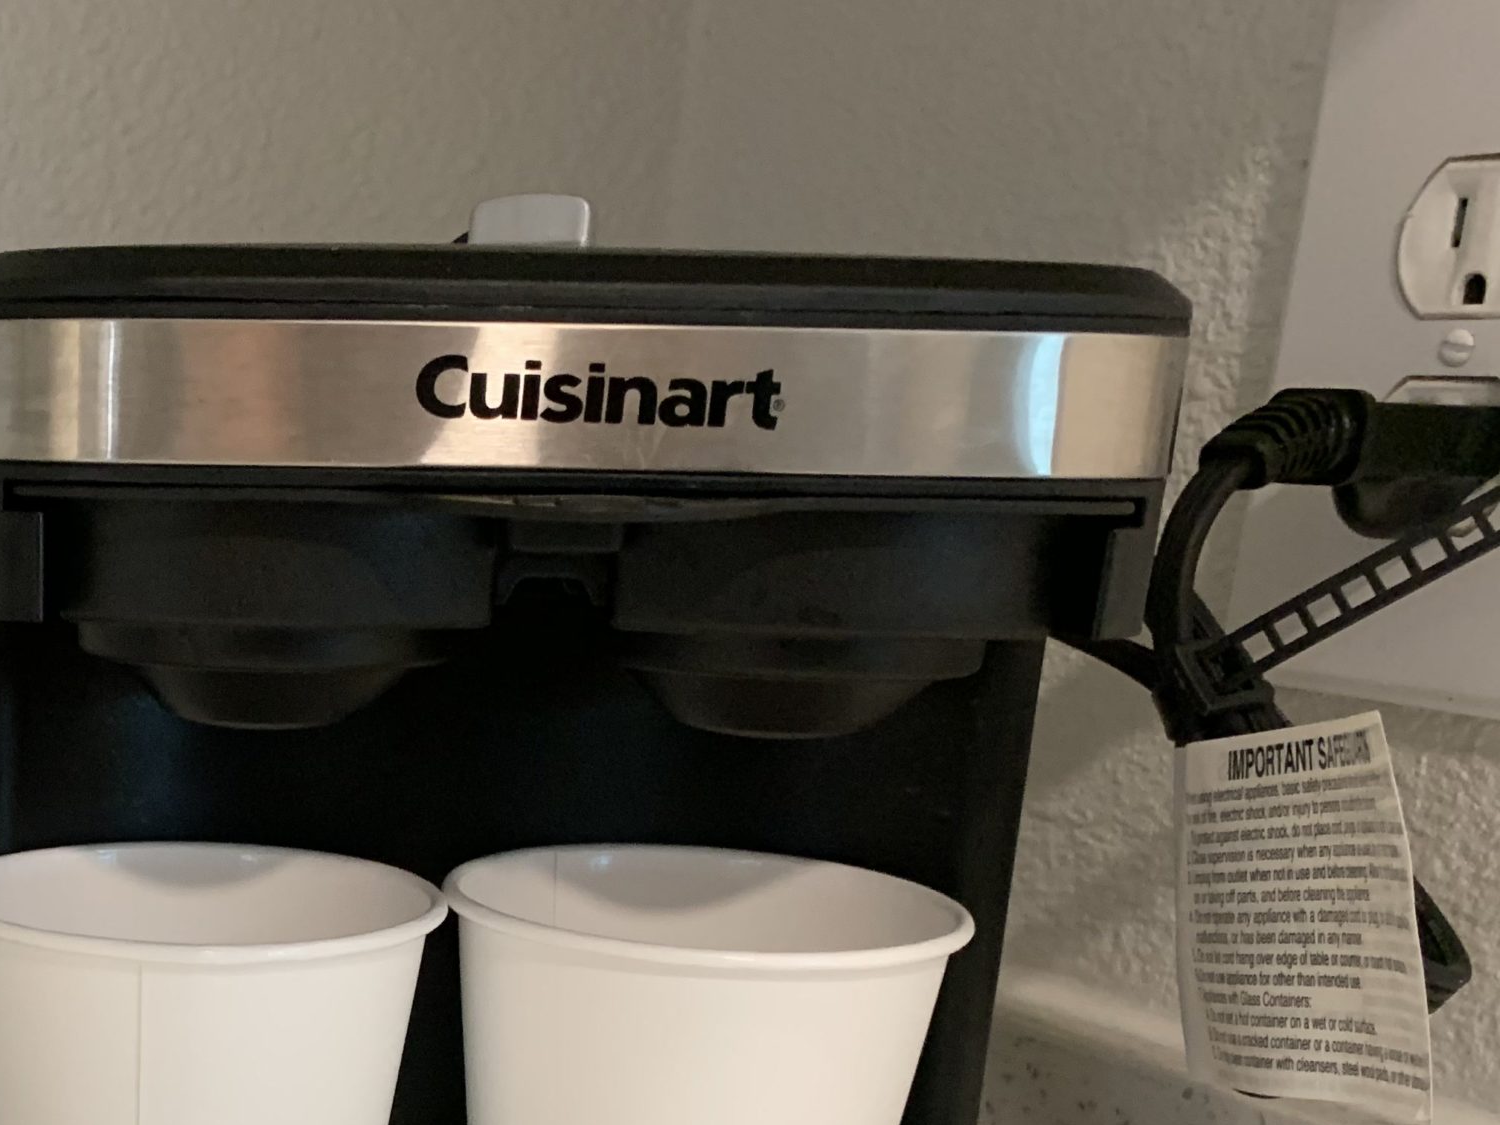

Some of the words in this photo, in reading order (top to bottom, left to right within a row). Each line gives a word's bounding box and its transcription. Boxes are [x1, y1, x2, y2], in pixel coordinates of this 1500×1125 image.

[416, 354, 782, 431] Cuisinart
[1228, 739, 1314, 781] IMPORTANT
[1256, 847, 1295, 863] necessary
[1297, 844, 1317, 858] when
[1249, 867, 1271, 882] when
[1296, 866, 1310, 880] use
[1312, 865, 1326, 880] and
[1260, 887, 1276, 902] and
[1278, 887, 1301, 902] before
[1237, 911, 1251, 928] any
[1254, 907, 1291, 926] appliance
[1240, 930, 1255, 944] has
[1256, 931, 1276, 945] been
[1278, 928, 1315, 948] damaged
[1236, 951, 1255, 969] hang
[1256, 952, 1274, 966] over
[1276, 949, 1298, 970] edge
[1310, 950, 1329, 966] table
[1272, 971, 1295, 987] other
[1297, 971, 1316, 987] than
[1241, 989, 1261, 1006] Glass
[1263, 990, 1312, 1009] Containers:
[1251, 1013, 1288, 1028] container
[1312, 1016, 1326, 1030] wet
[1338, 1016, 1353, 1033] cold
[1271, 1036, 1311, 1051] container
[1332, 1040, 1364, 1055] container
[1276, 1056, 1294, 1071] with
[1296, 1056, 1341, 1076] cleansers,
